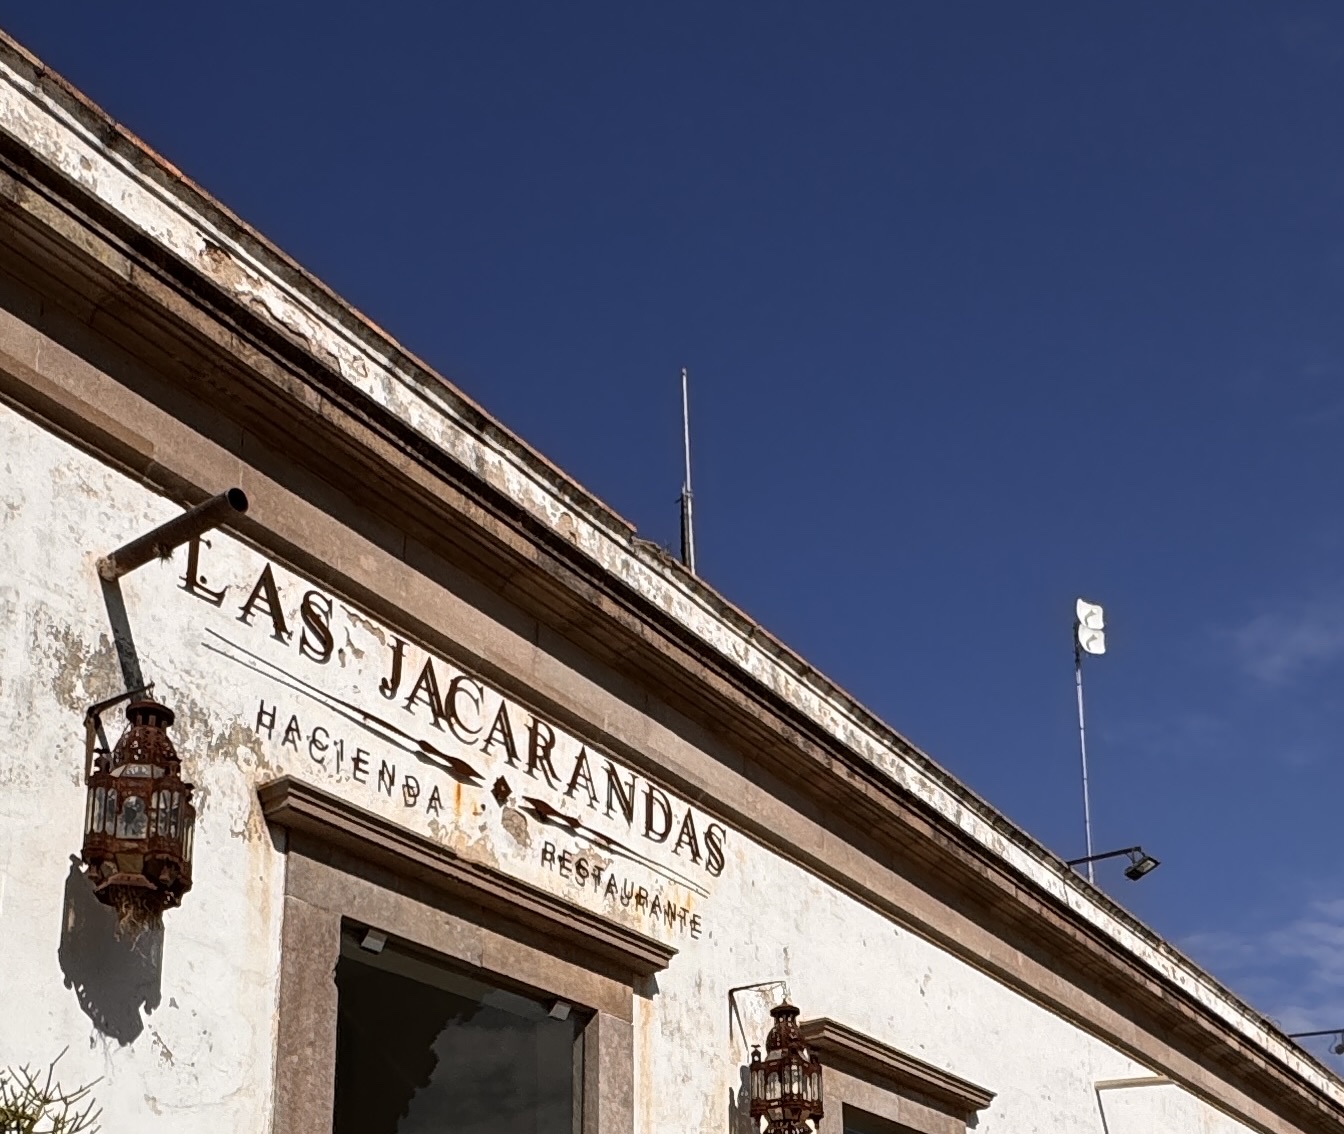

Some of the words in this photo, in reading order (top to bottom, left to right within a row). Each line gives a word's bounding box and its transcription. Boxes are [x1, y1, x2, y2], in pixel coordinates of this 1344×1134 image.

[178, 536, 335, 662] LAS
[379, 635, 726, 875] JACARANDAS
[257, 700, 444, 814] HACIENDA
[541, 840, 703, 938] RESTAURANTE
